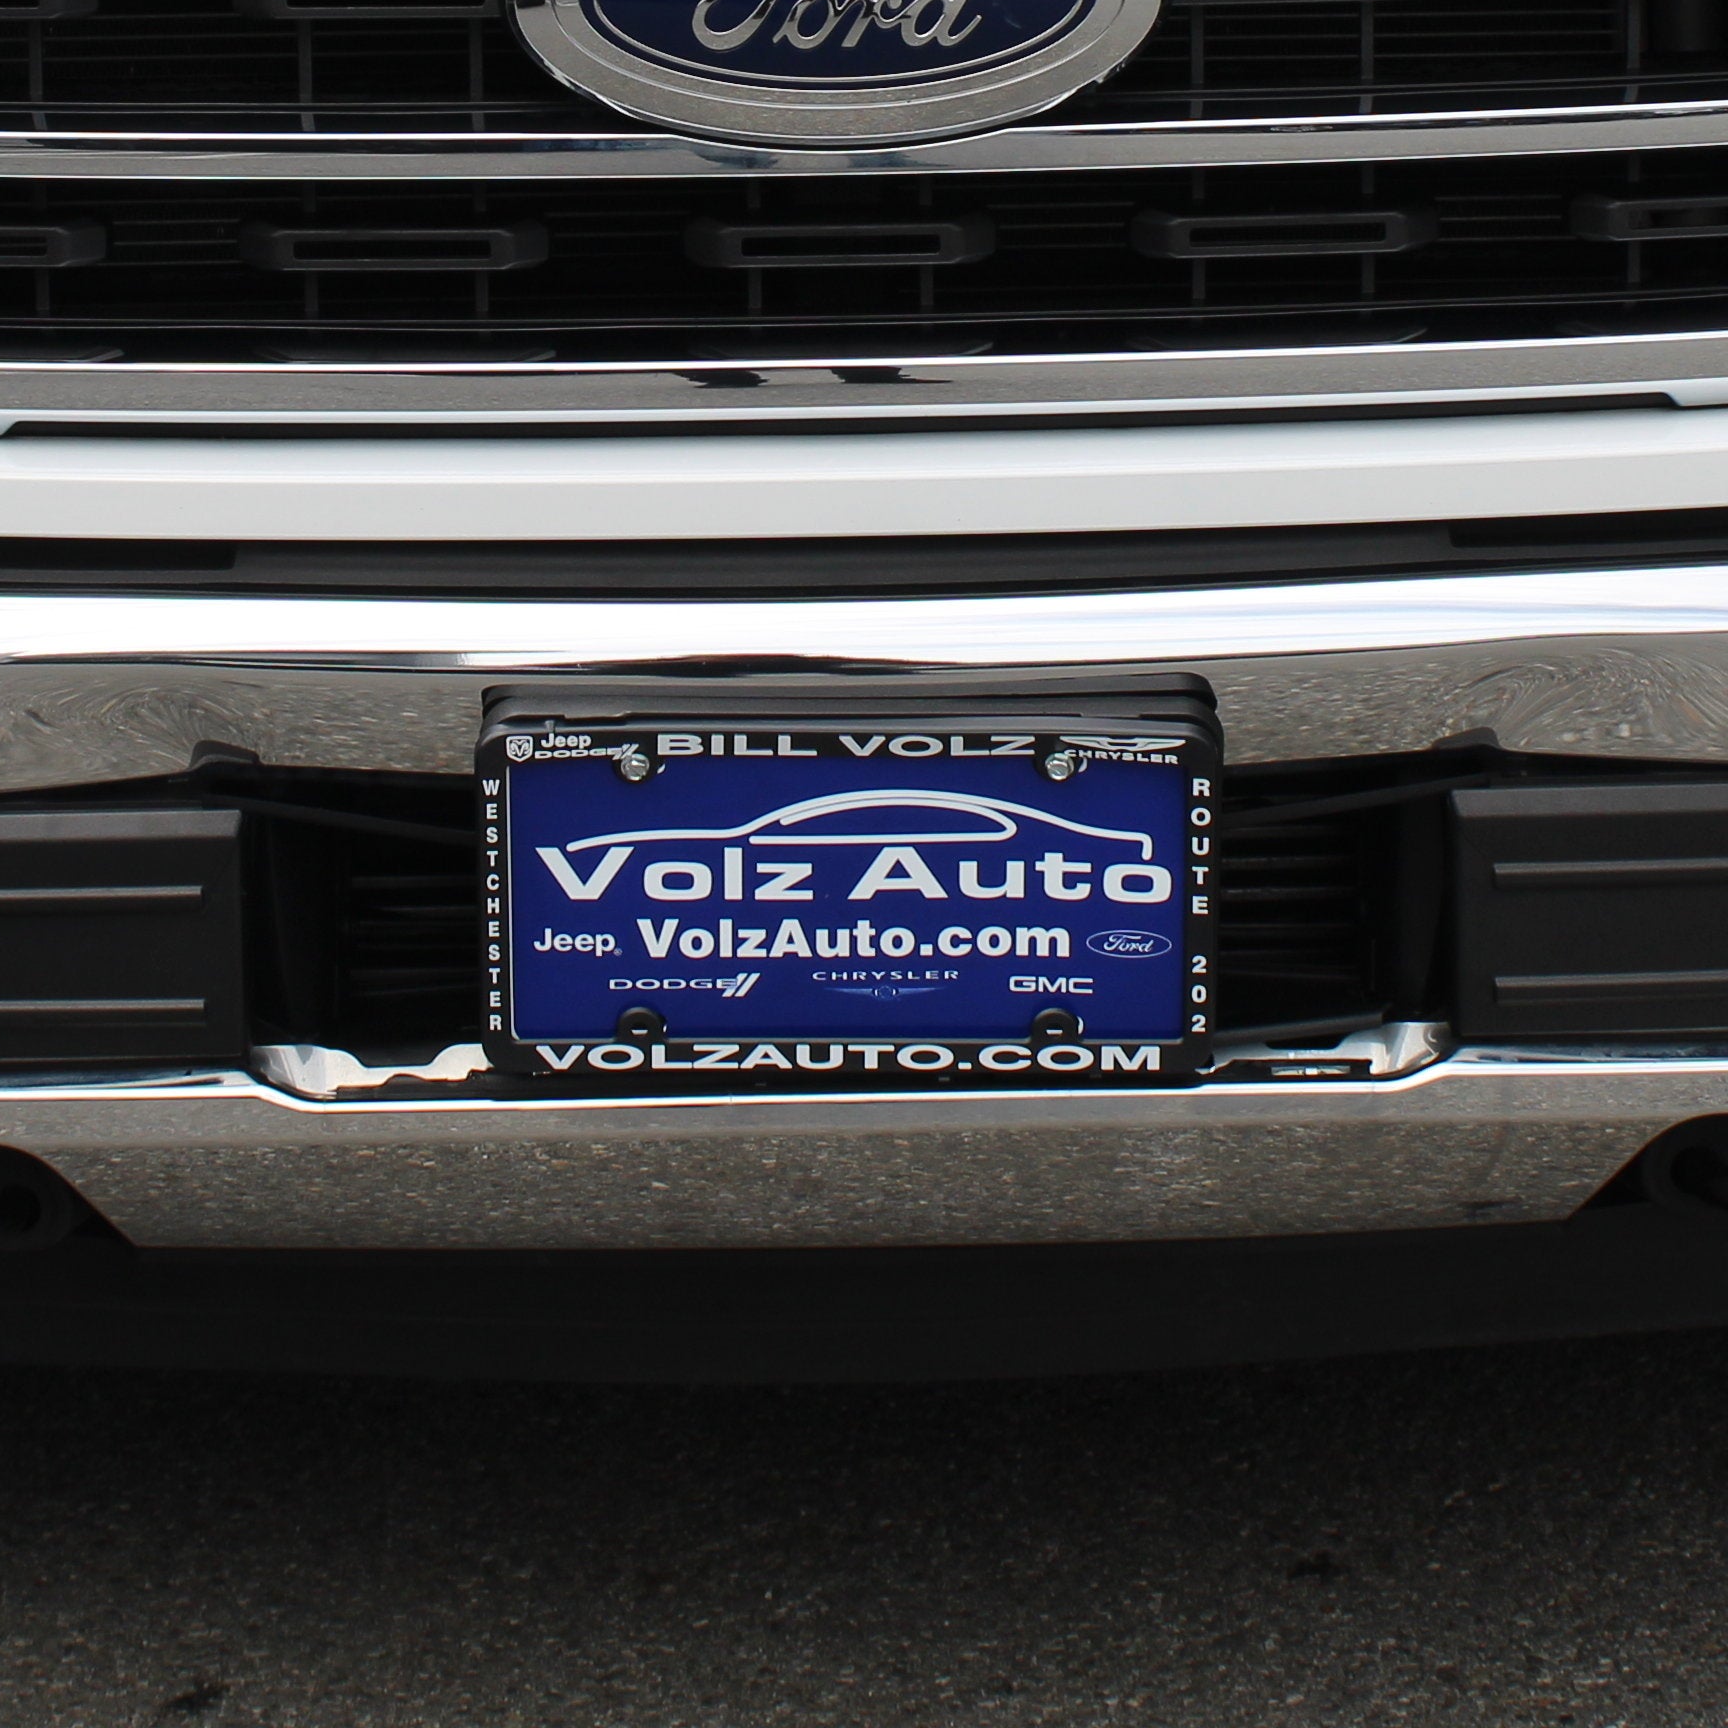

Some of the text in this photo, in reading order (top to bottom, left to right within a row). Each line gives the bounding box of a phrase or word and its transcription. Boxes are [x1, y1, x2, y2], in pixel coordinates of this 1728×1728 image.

[540, 733, 592, 749] Jeep
[657, 733, 1036, 757] BILL VOLZ
[1063, 749, 1179, 765] CHRYSLER
[535, 846, 1172, 904] Volz Auto
[482, 779, 503, 1032] WESTCHESTER
[1190, 777, 1212, 1033] ROUTE 202
[533, 928, 616, 957] Jeep
[636, 918, 1071, 959] VolzAuto.com
[1102, 935, 1155, 954] Ford
[609, 978, 738, 990] DODGE
[812, 970, 960, 982] CHRYSLER
[1009, 975, 1094, 995] GMC
[535, 1043, 1161, 1072] VOLZAUTO.COM
